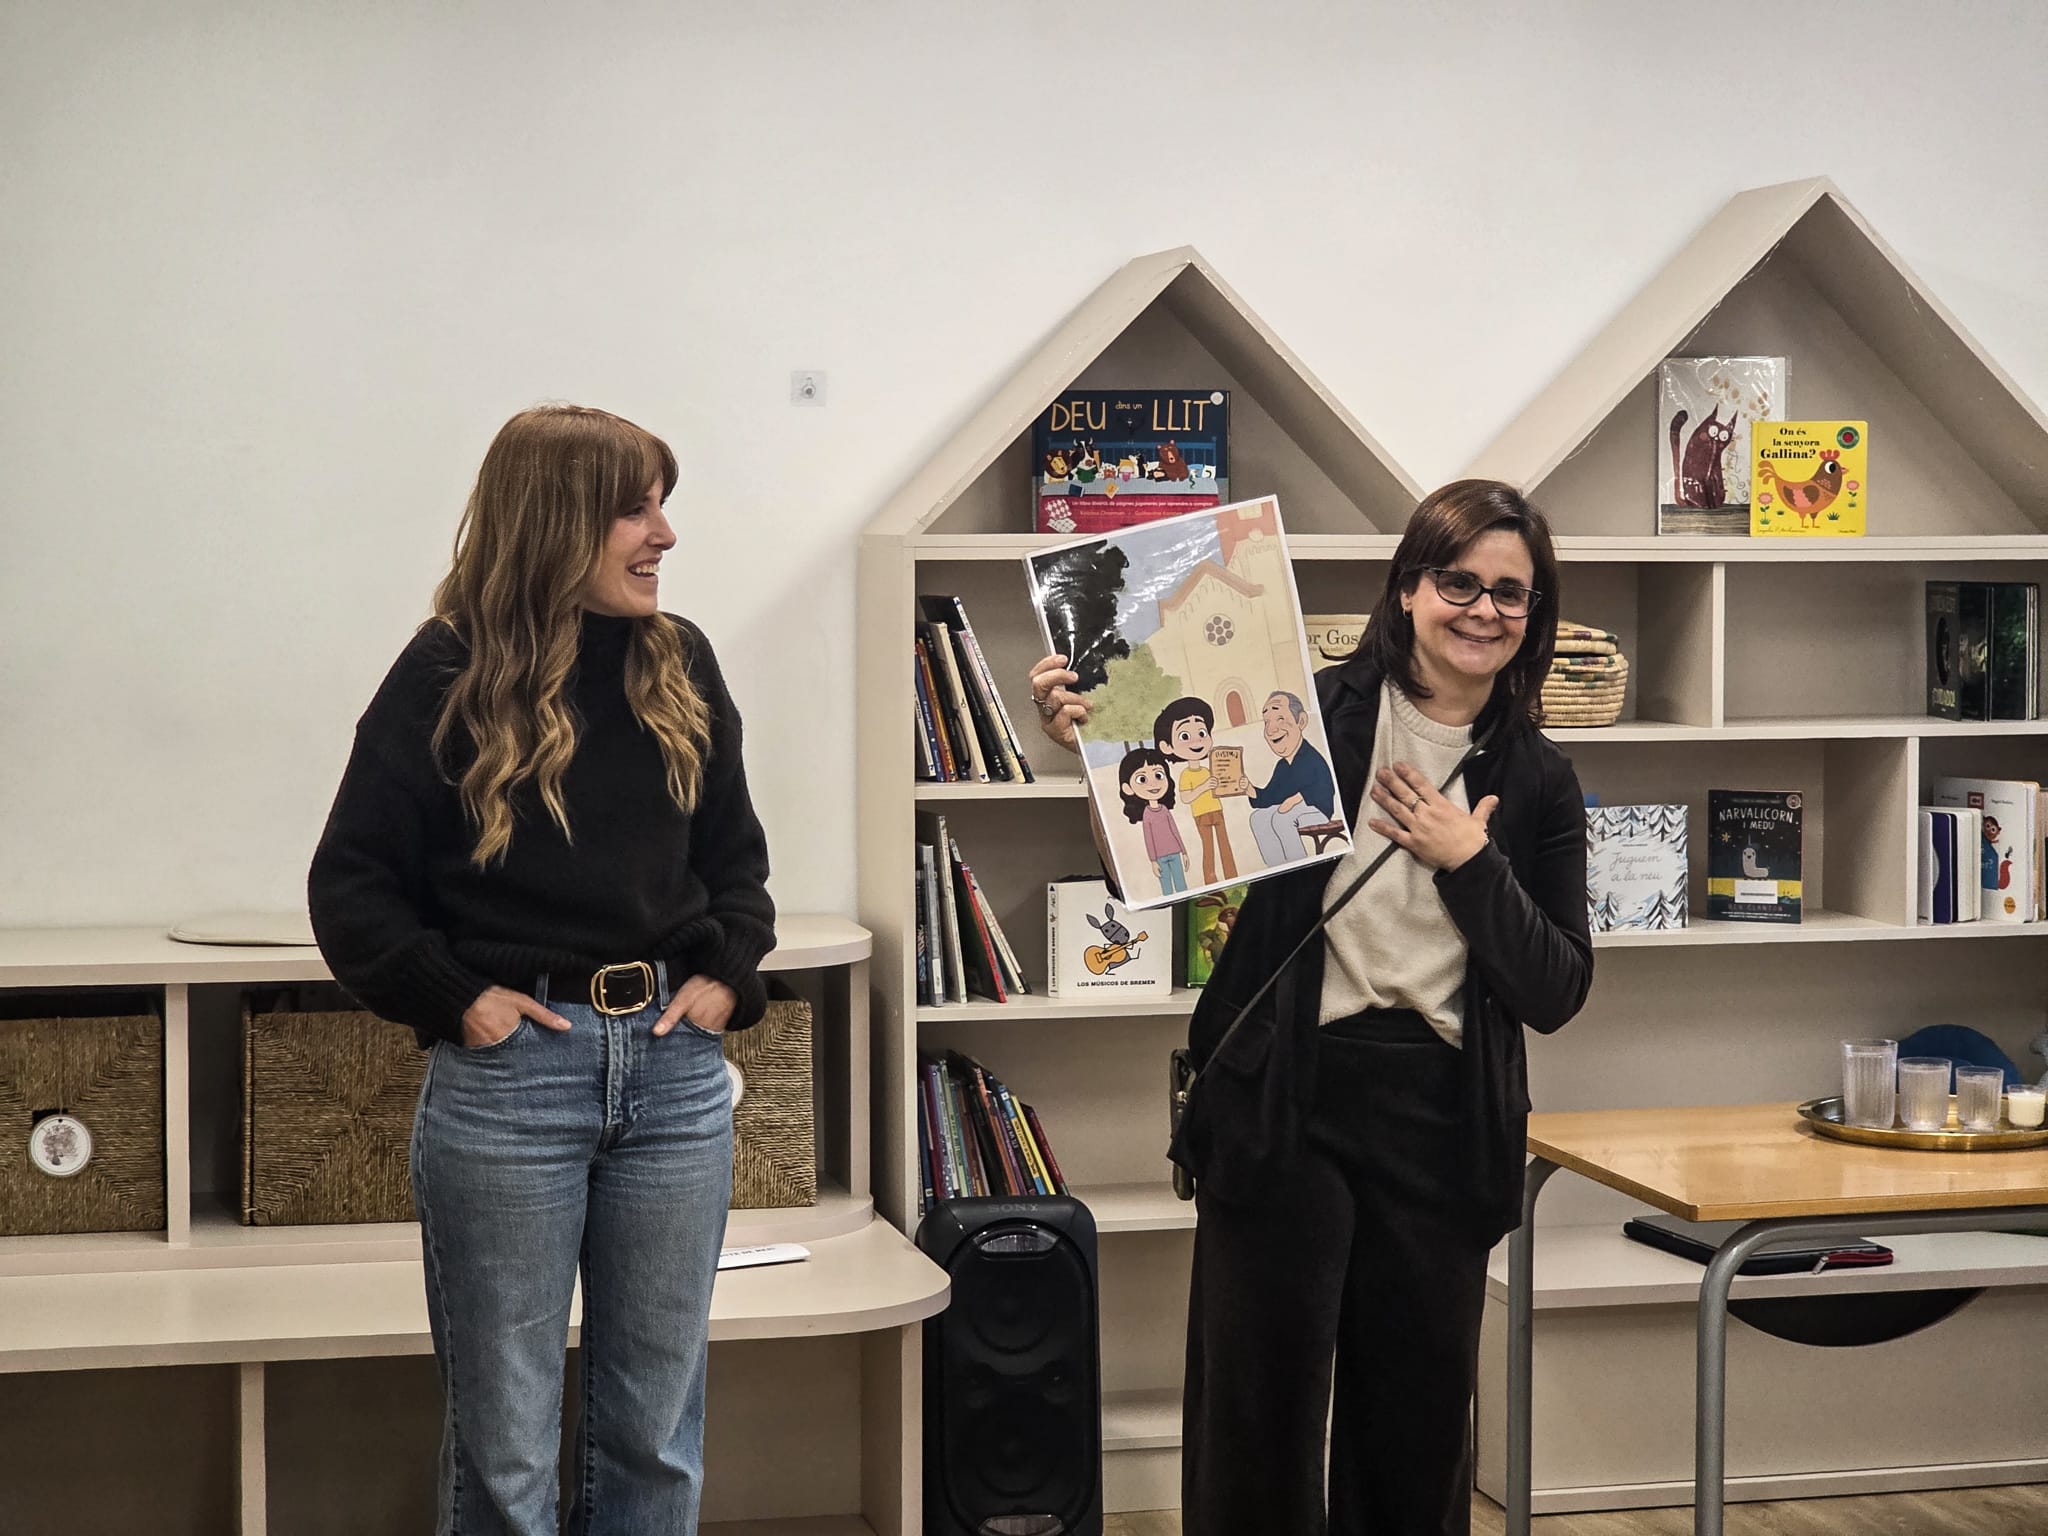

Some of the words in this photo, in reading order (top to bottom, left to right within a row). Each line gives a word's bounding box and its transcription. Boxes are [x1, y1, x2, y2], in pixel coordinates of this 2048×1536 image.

[1051, 401, 1106, 432] DEU
[1115, 400, 1131, 410] dins
[1152, 399, 1211, 432] LLIT
[1779, 427, 1794, 436] On
[1796, 427, 1807, 436] és
[1772, 438, 1782, 446] la
[1783, 440, 1820, 448] senyora
[1760, 448, 1816, 459] Gallina?
[1326, 629, 1359, 645] Gos
[1719, 807, 1794, 824] NARVALICORN
[1749, 821, 1775, 830] MEDU
[1609, 852, 1663, 872] Juguem
[1611, 873, 1621, 882] a
[1623, 870, 1637, 881] la
[1639, 872, 1663, 881] neu
[988, 1203, 1039, 1213] SONY
